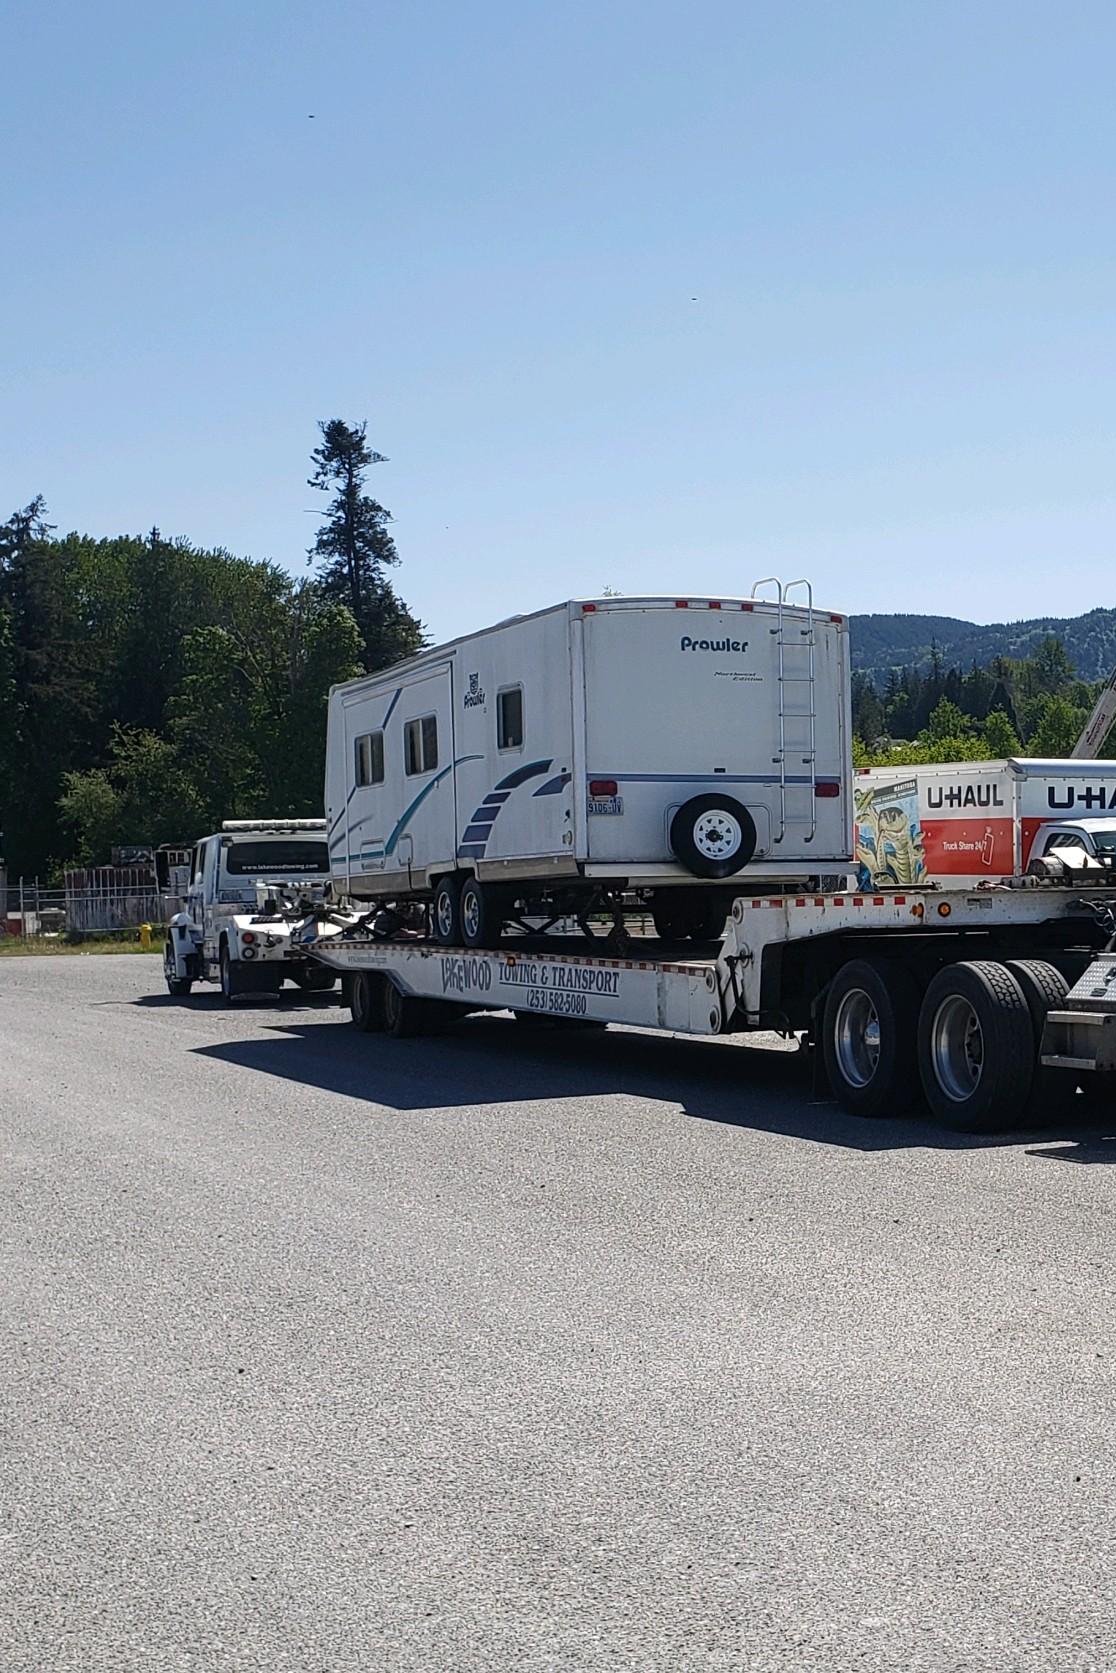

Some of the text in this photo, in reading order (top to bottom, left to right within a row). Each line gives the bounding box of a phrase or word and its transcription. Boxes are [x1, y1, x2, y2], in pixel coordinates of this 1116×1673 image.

[681, 636, 748, 652] Prowler
[928, 784, 1003, 808] U-HAUL
[943, 840, 987, 852] Truck Share 24/7
[441, 957, 491, 993] LAKEWOOD
[499, 962, 620, 993] TOWING & TRANSPORT
